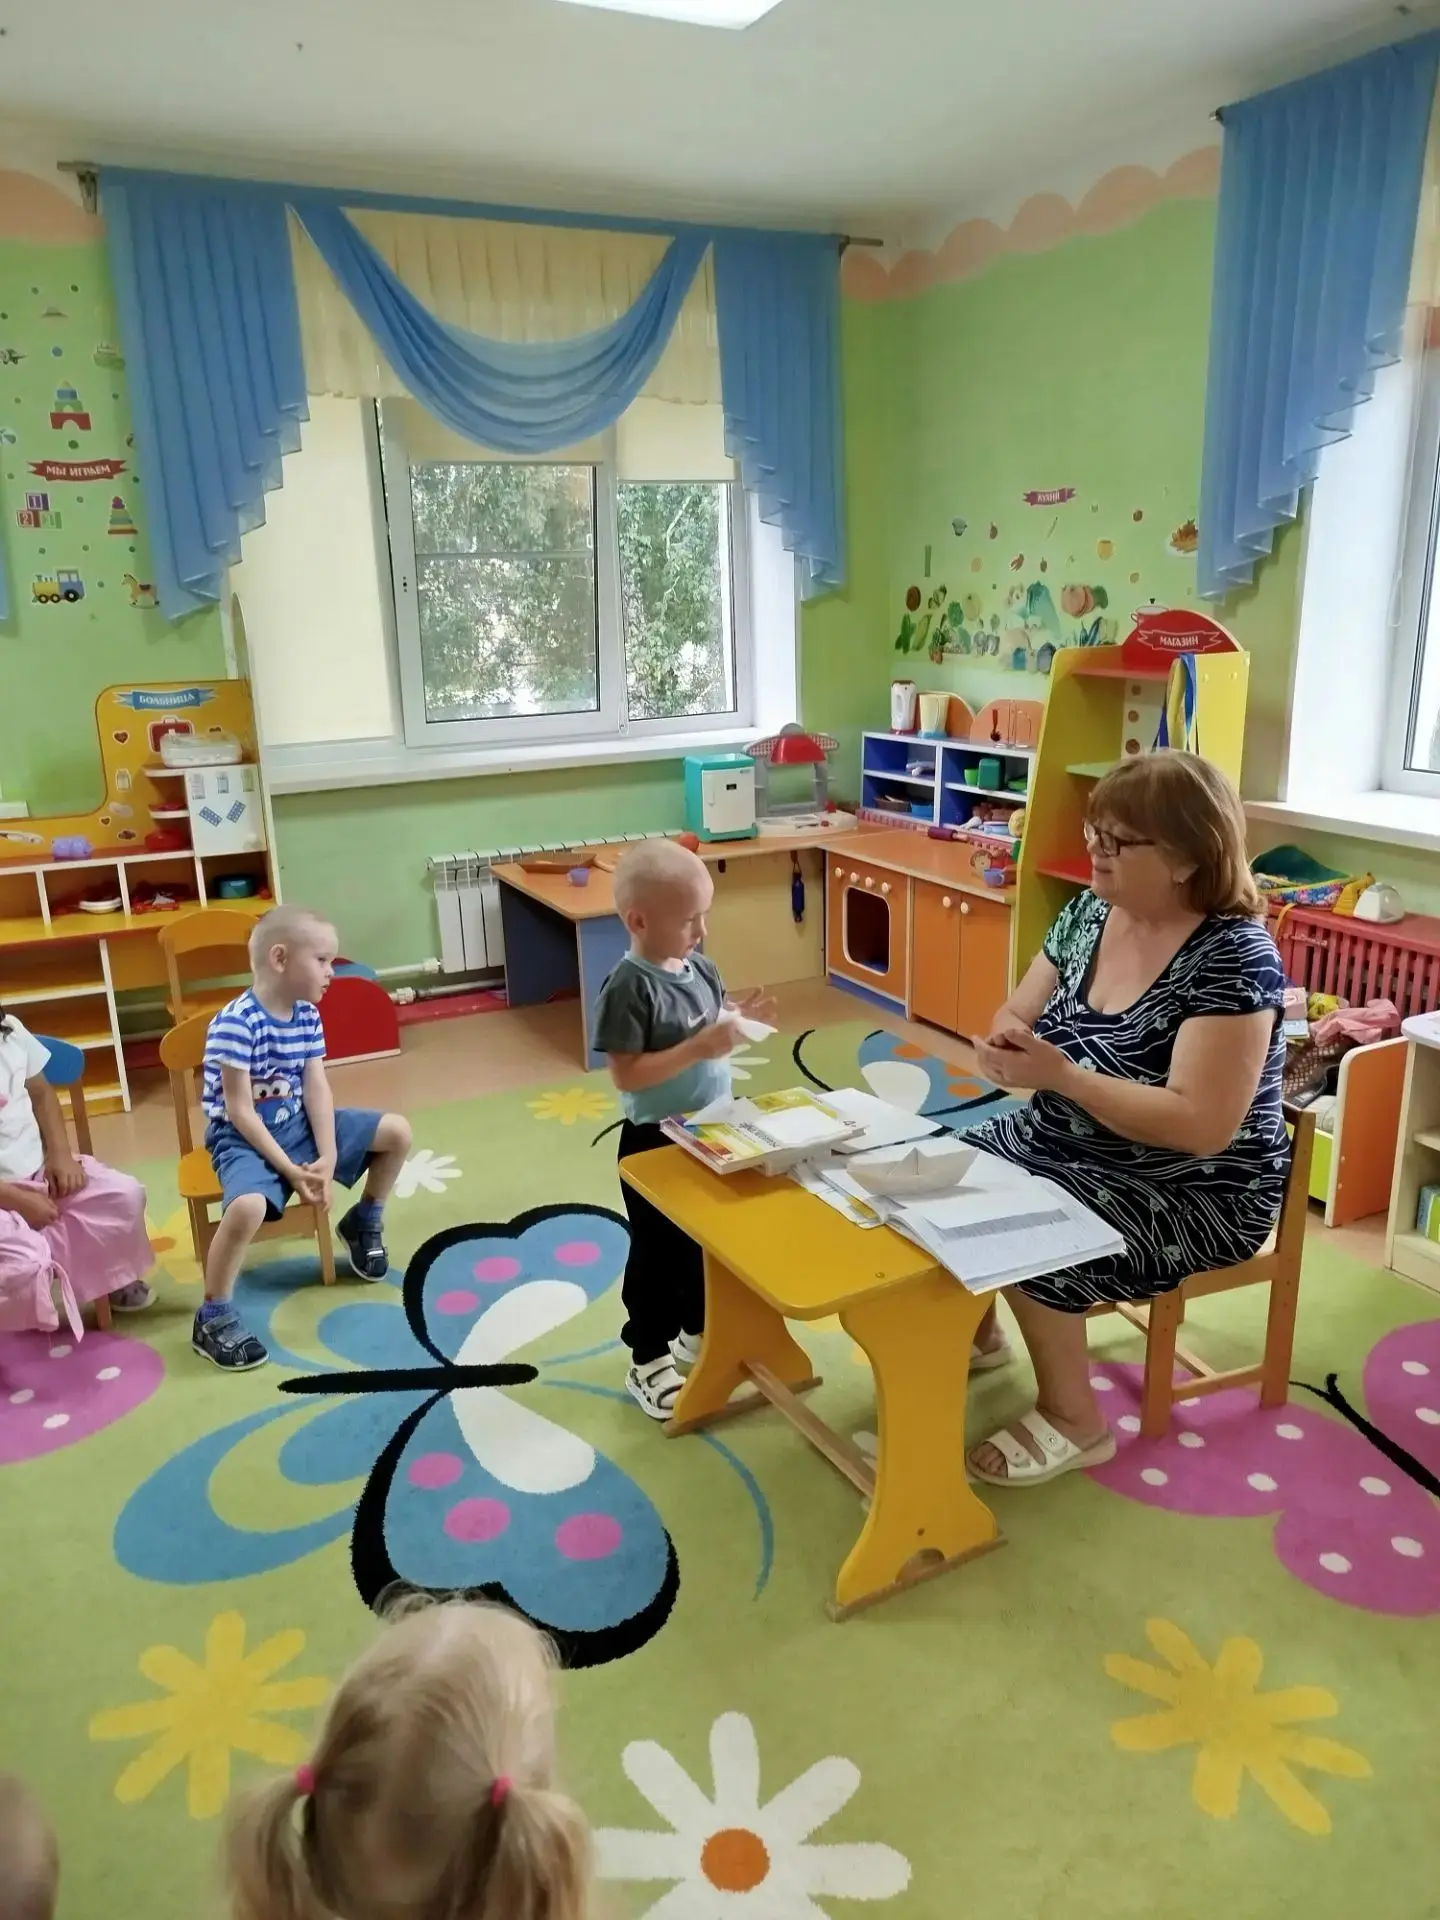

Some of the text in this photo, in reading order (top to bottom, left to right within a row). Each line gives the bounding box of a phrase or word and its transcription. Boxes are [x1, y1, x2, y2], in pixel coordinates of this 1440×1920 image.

[46, 464, 112, 477] МЫ ИГРАЕМ
[1160, 635, 1199, 647] МАГАЗИН
[139, 693, 196, 705] БОЛЬНИЦА
